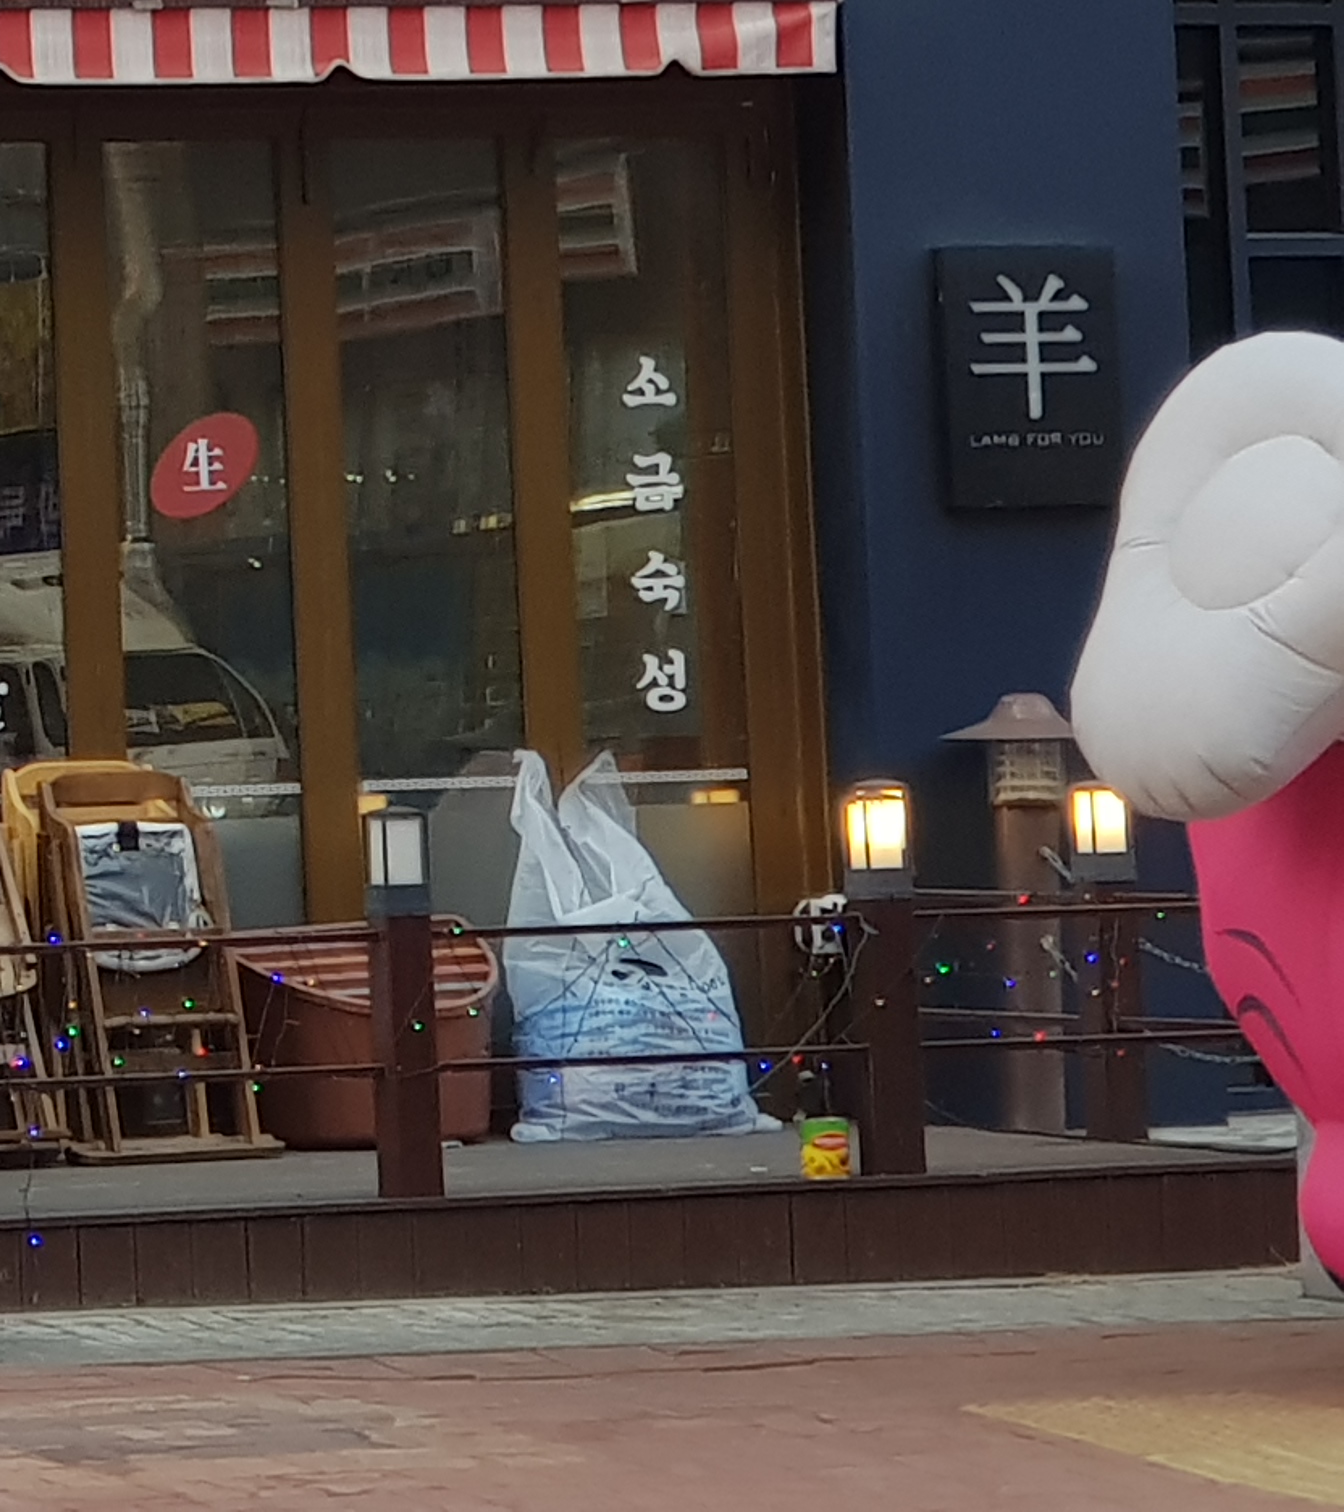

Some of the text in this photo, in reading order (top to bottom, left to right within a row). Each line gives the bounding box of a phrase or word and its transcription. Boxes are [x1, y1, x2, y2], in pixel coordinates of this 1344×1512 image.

[967, 272, 1099, 421] 羊
[181, 437, 229, 494] 生
[1068, 431, 1105, 447] YOU
[620, 355, 688, 713] 소금숙성
